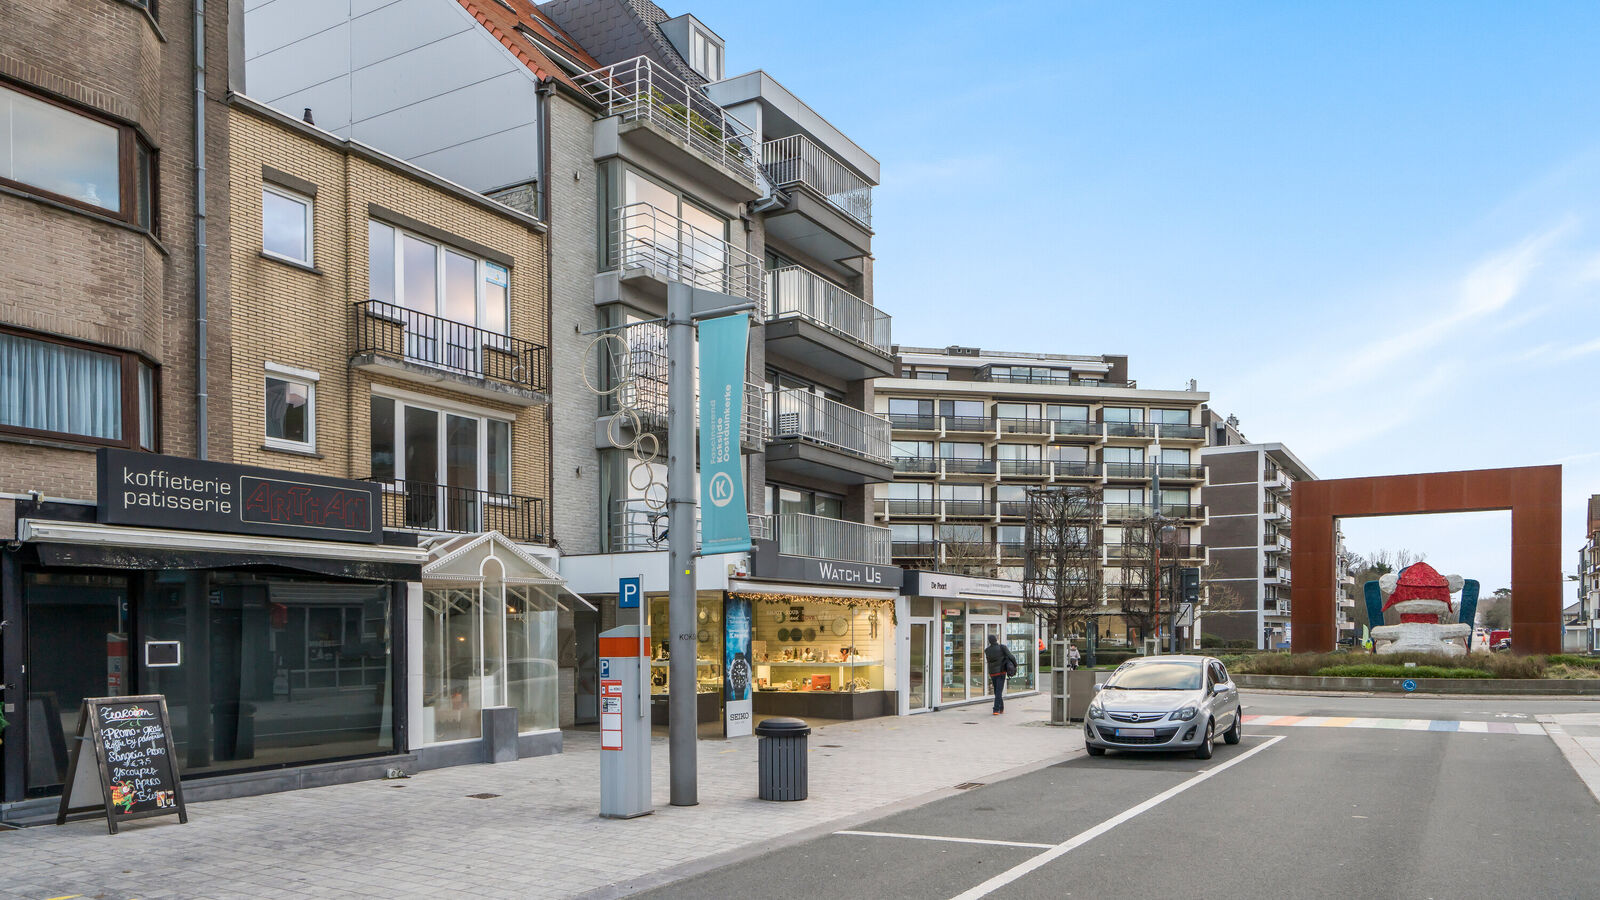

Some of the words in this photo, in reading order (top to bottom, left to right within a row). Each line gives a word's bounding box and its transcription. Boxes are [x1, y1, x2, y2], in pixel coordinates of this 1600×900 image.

[124, 466, 231, 495] koffieterie
[124, 491, 231, 513] patisserie
[624, 583, 637, 602] P
[601, 660, 609, 673] P
[729, 712, 750, 721] SEIKO
